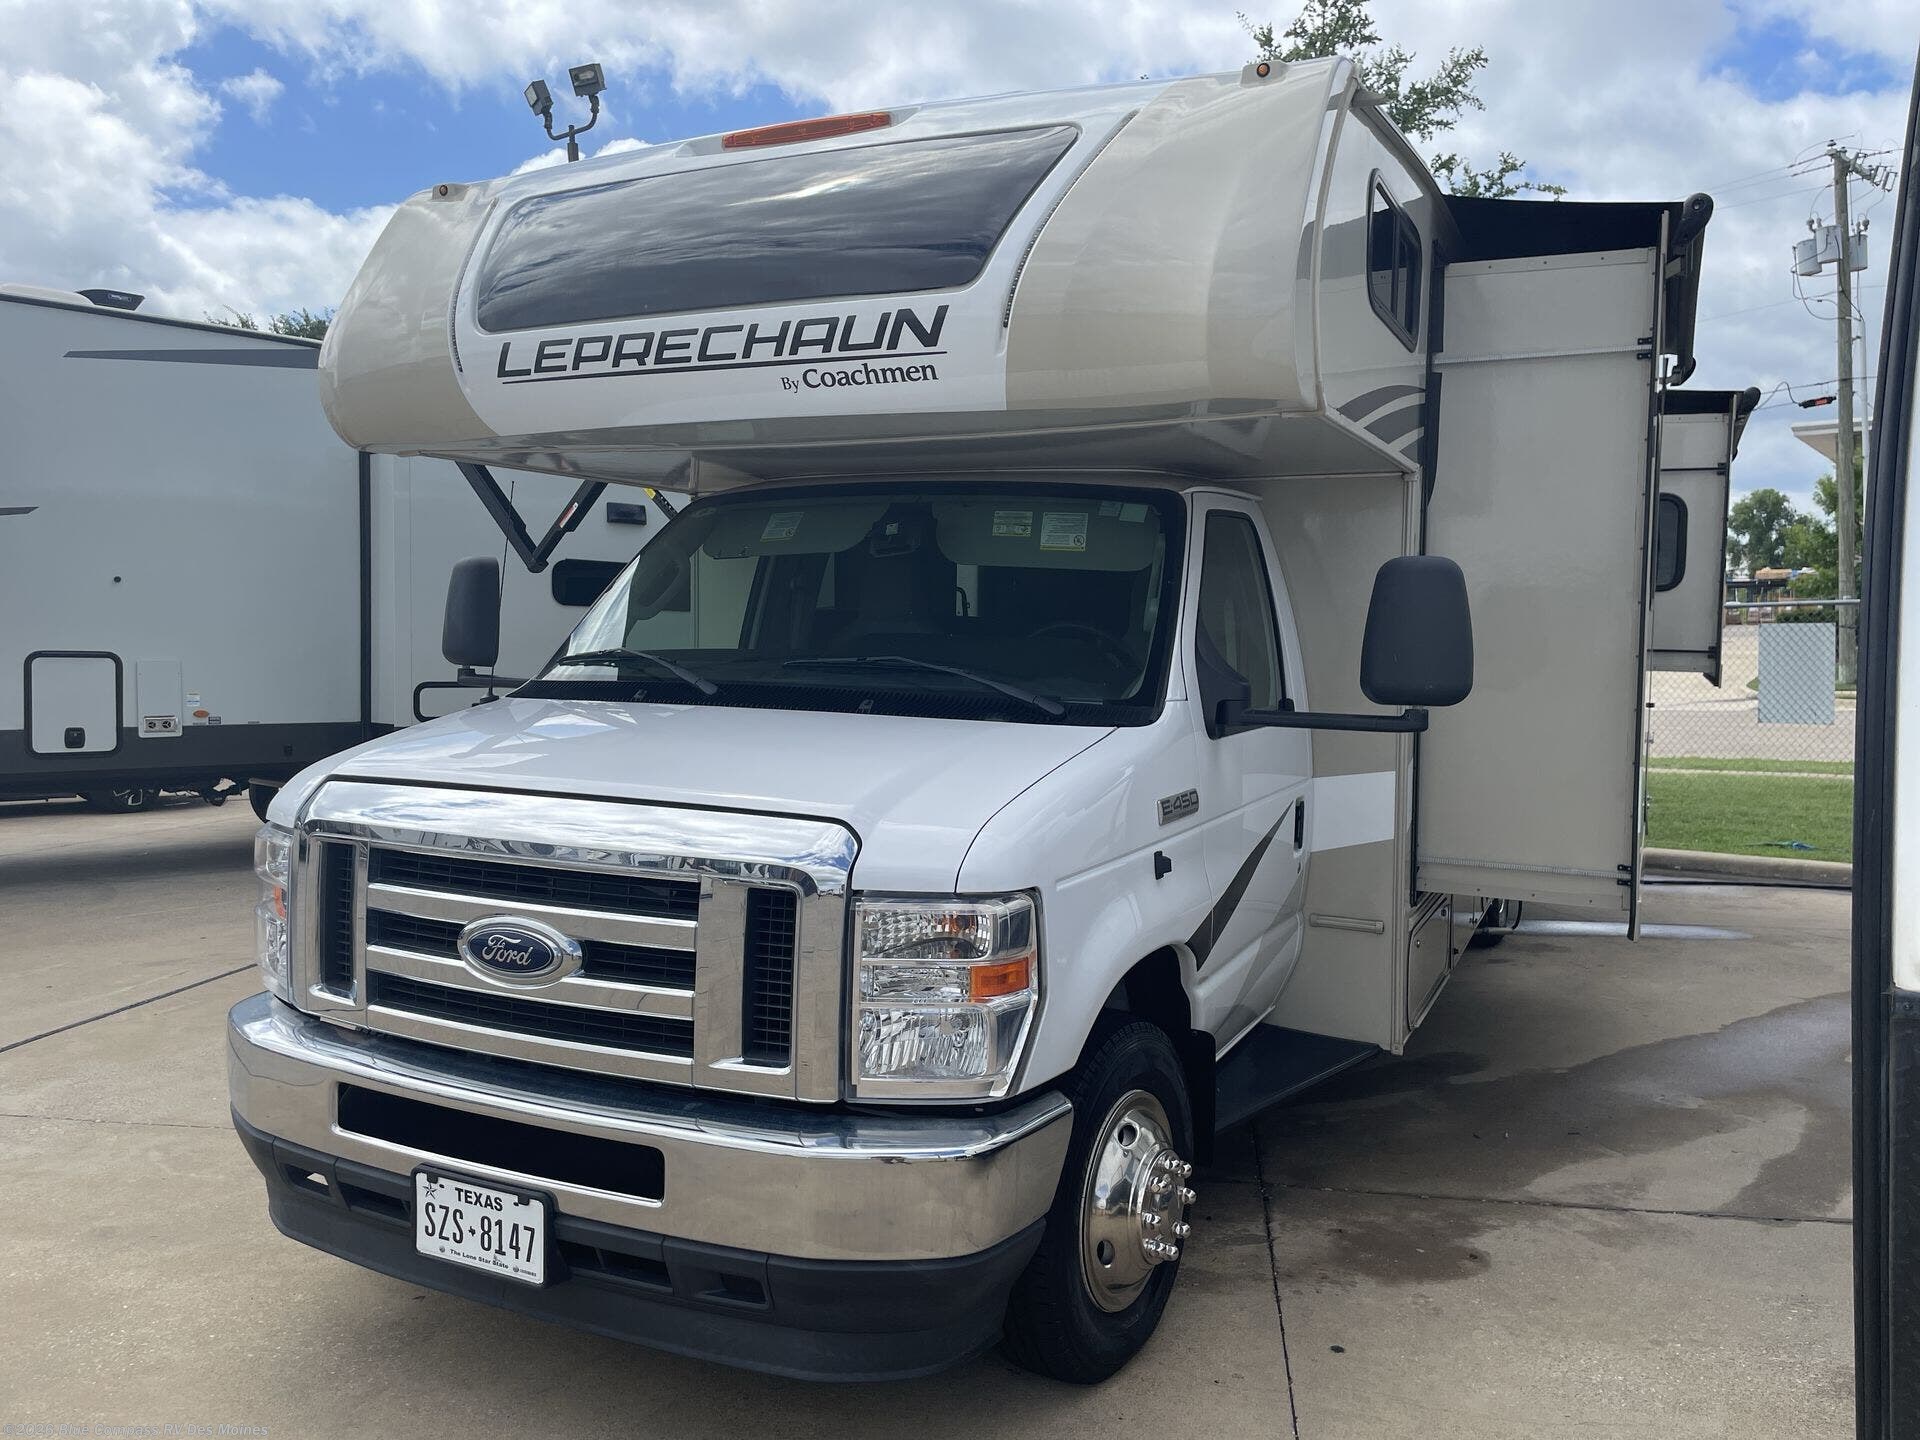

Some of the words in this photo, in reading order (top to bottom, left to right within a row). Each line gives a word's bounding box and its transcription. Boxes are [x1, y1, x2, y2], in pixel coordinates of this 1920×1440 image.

[497, 305, 949, 377] LEPRECHAUN
[781, 376, 800, 393] By
[802, 362, 938, 390] Coachmen
[482, 934, 533, 966] Ford
[455, 1187, 503, 1212] TEXAS
[450, 1249, 461, 1257] The
[462, 1252, 477, 1261] Lone
[478, 1257, 492, 1265] Star
[492, 1261, 509, 1270] State
